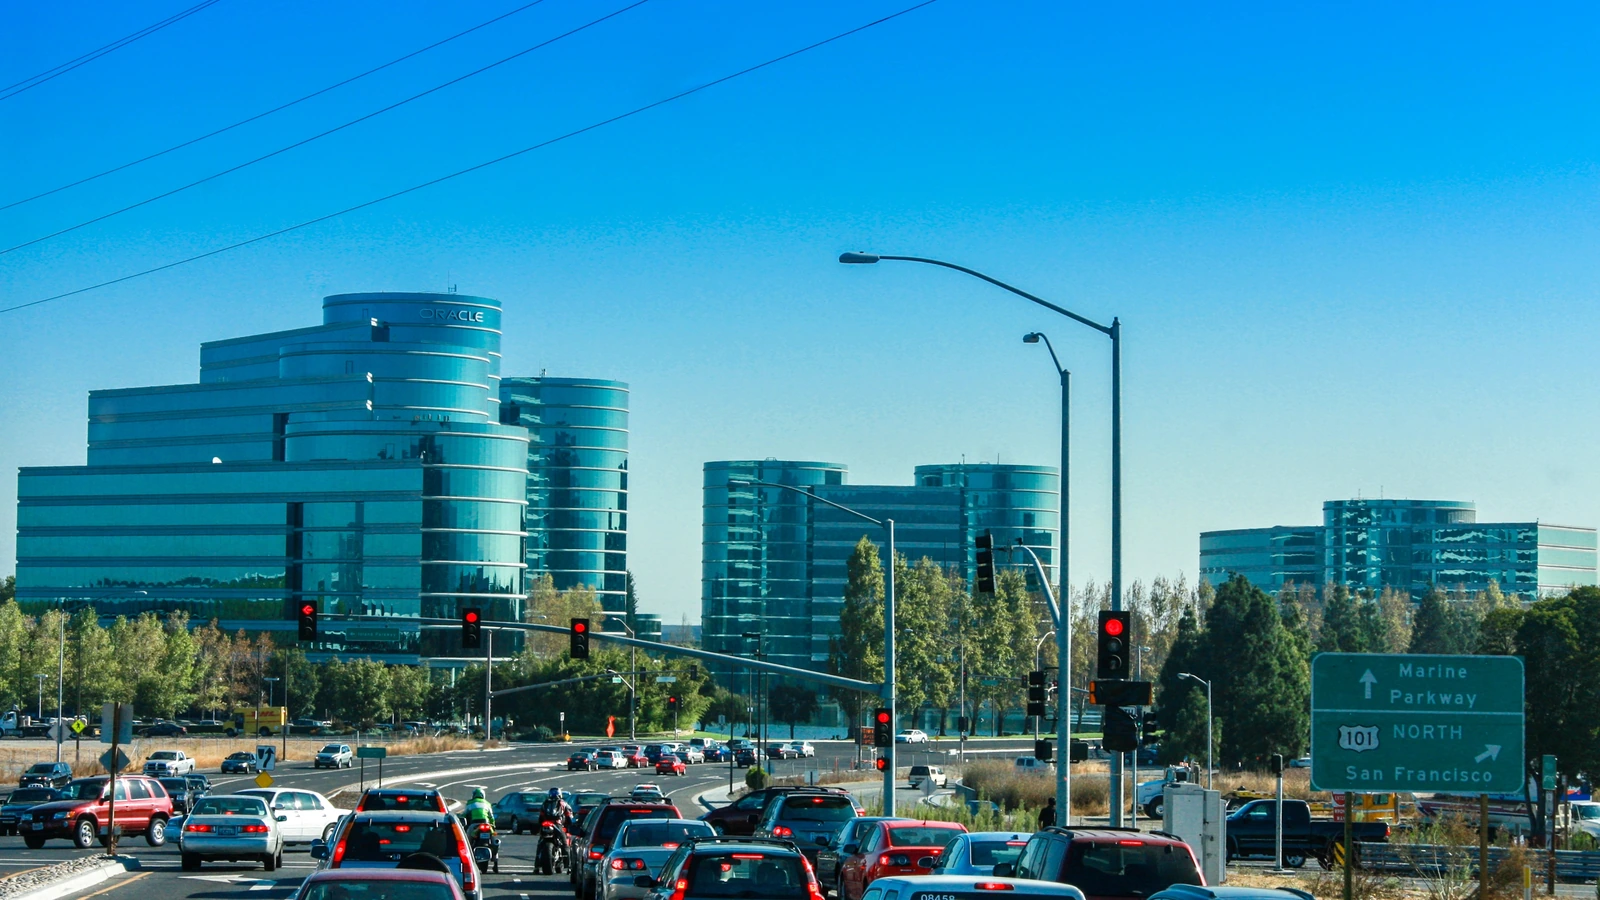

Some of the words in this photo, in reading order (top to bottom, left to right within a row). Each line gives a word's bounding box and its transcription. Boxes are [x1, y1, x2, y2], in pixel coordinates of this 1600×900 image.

[420, 308, 484, 322] ORACLE
[1399, 663, 1467, 679] Marine
[1390, 689, 1477, 708] Parkway
[1347, 731, 1372, 746] 101
[1393, 724, 1462, 740] NORTH
[1346, 766, 1383, 781] San
[1394, 766, 1492, 782] Francisco
